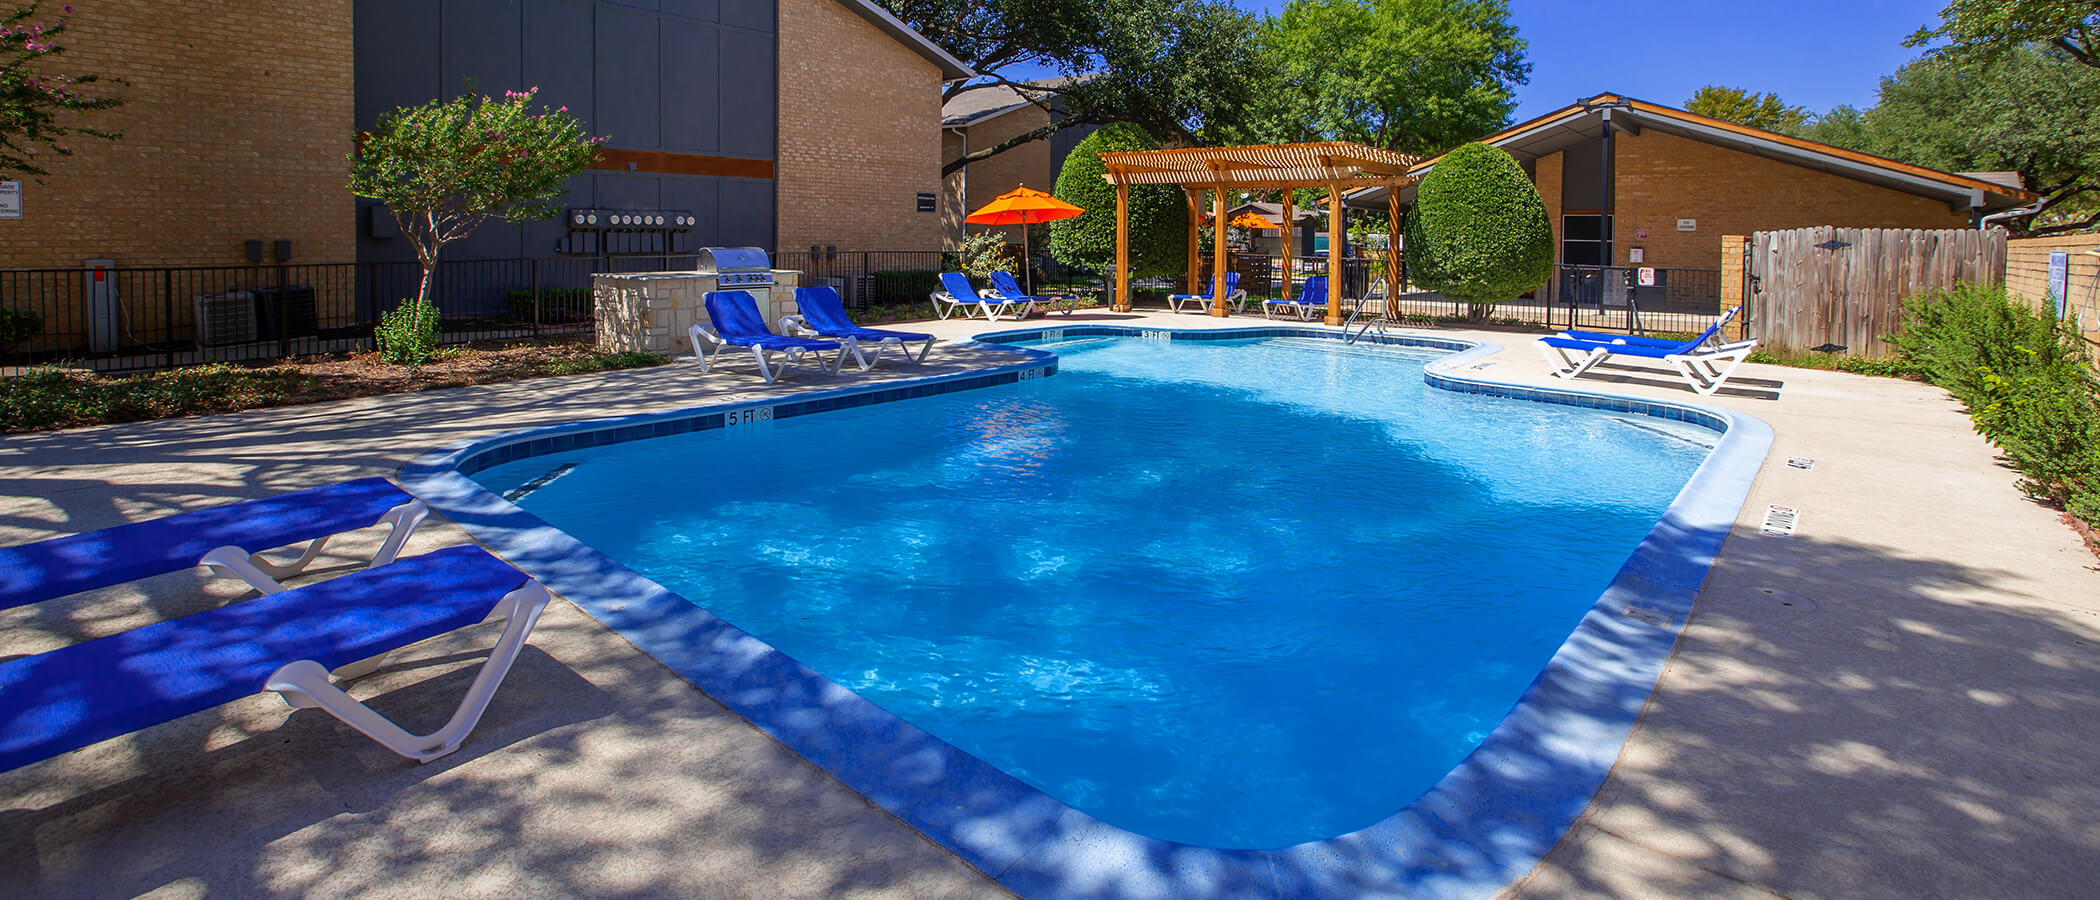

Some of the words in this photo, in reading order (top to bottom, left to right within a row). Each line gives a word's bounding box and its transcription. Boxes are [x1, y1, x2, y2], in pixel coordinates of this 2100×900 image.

[1028, 368, 1035, 380] FT
[729, 411, 738, 425] 5
[743, 409, 756, 424] FT
